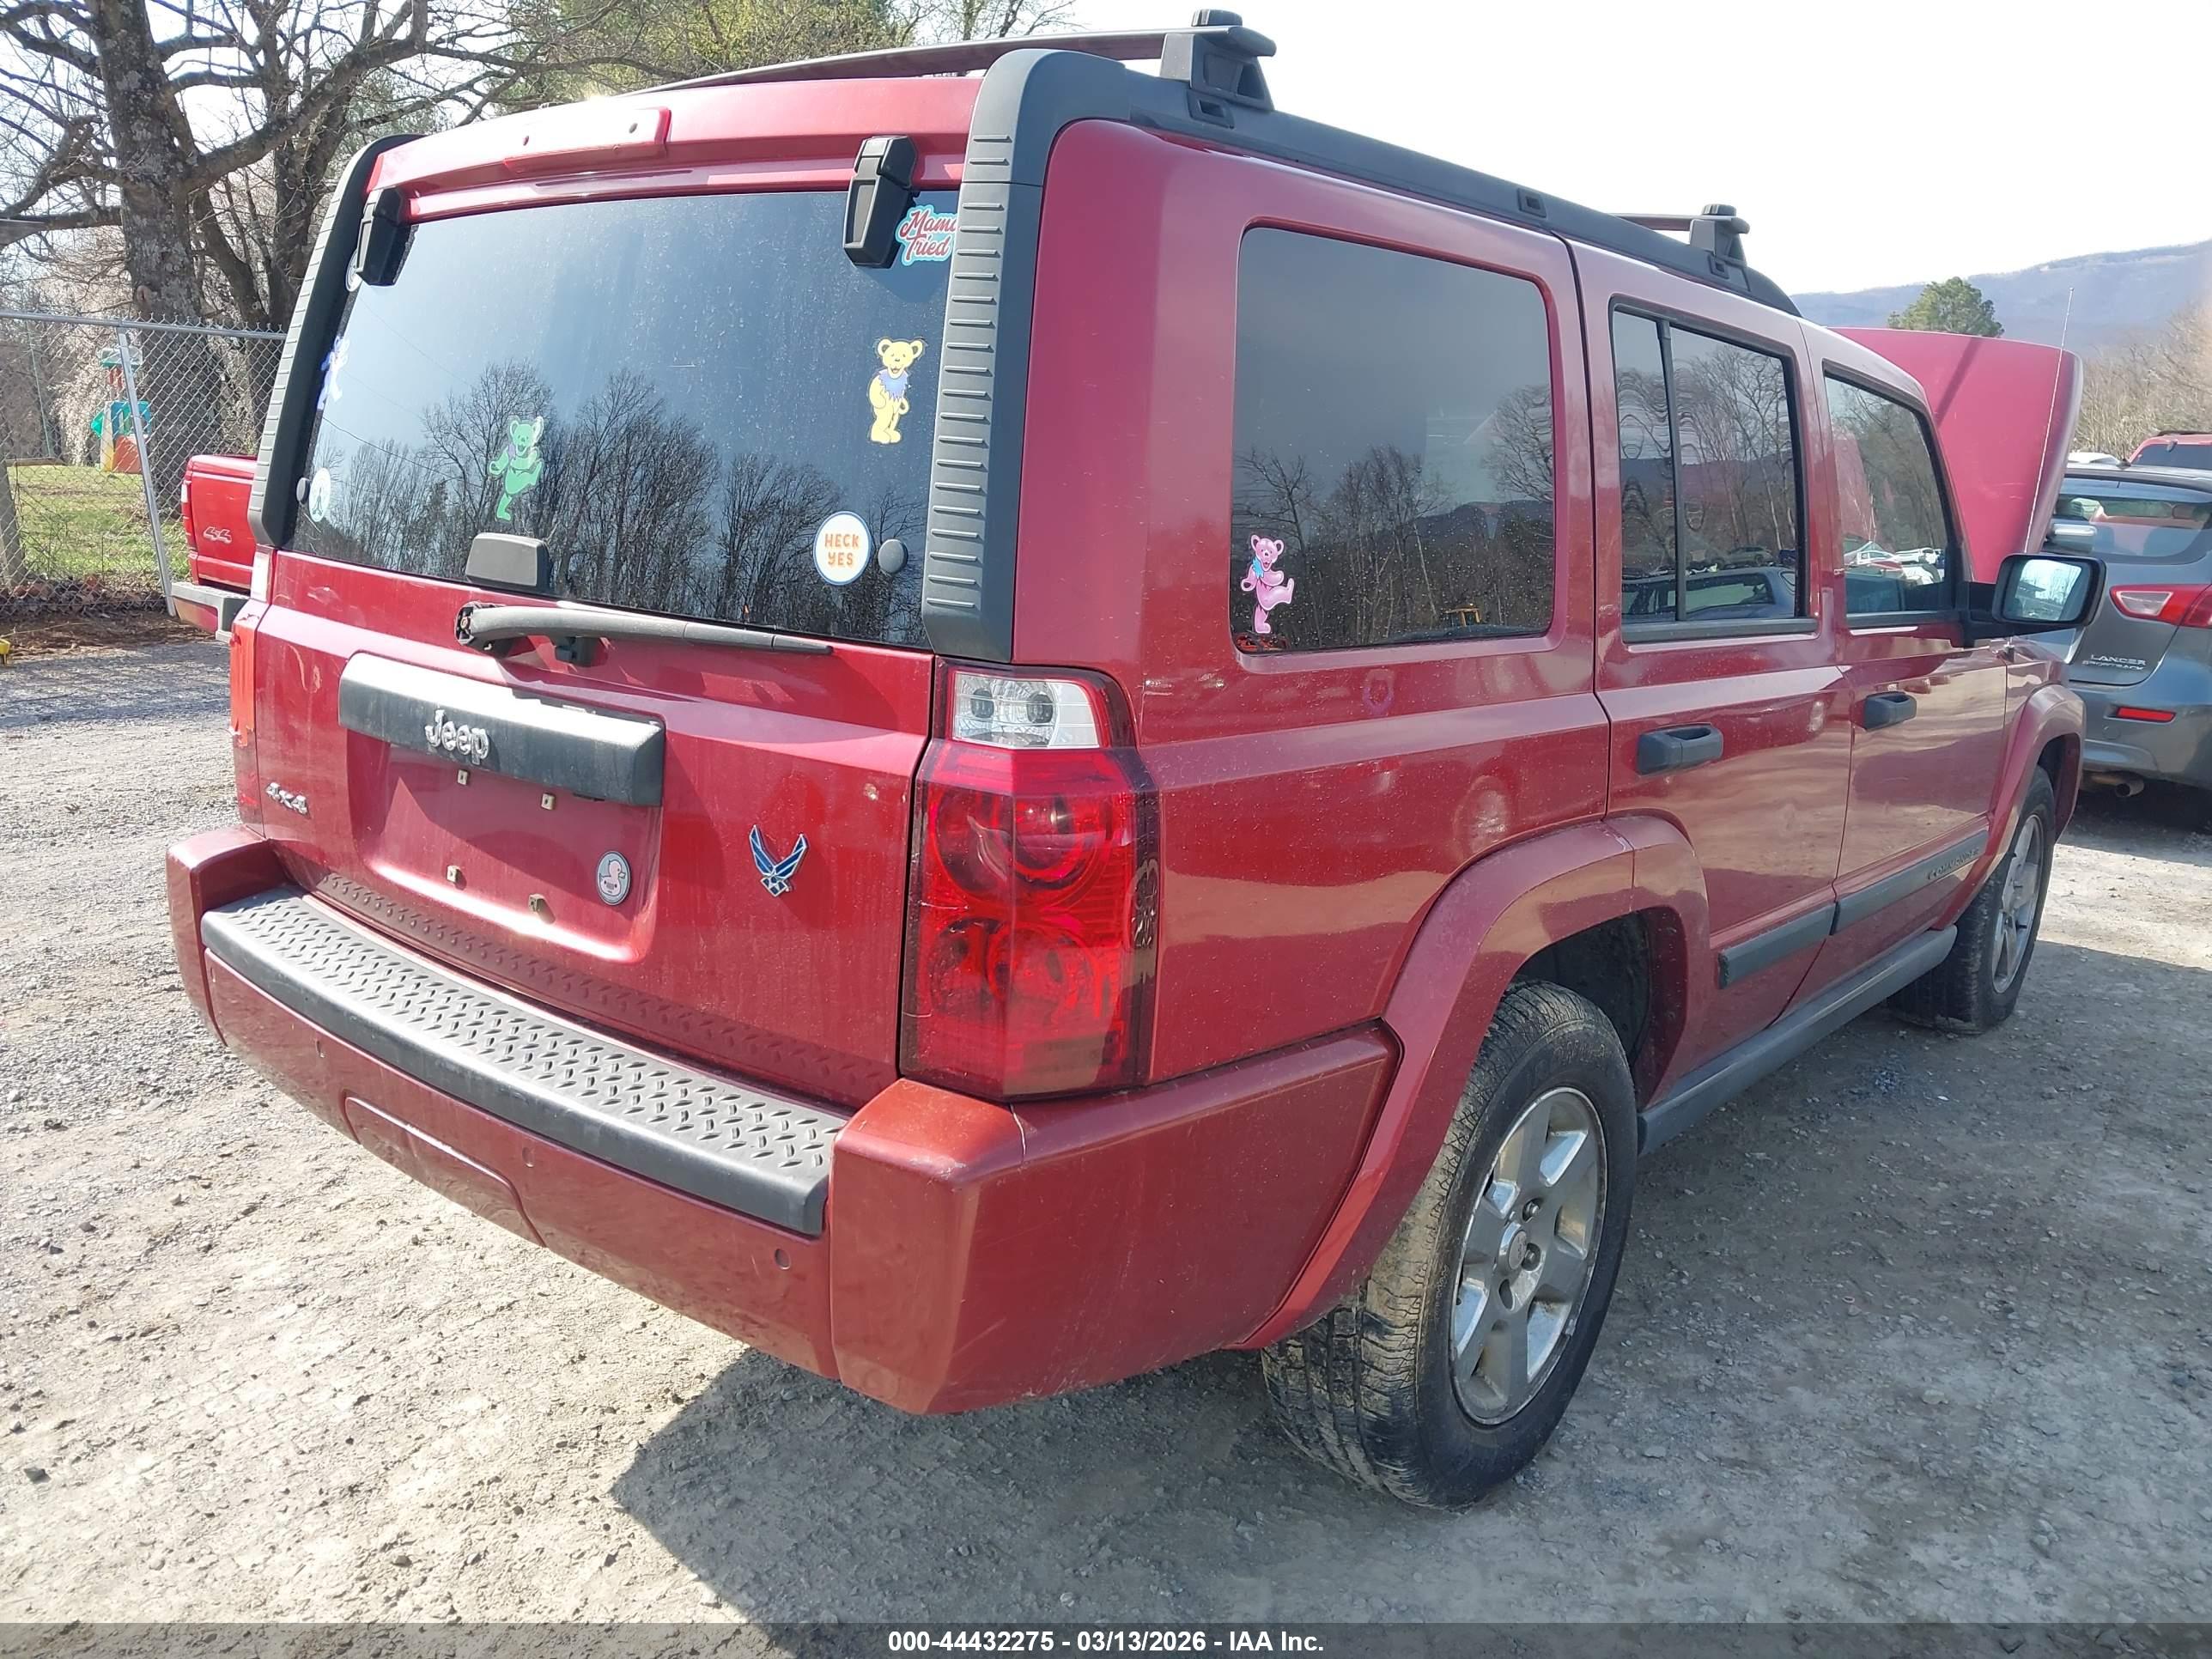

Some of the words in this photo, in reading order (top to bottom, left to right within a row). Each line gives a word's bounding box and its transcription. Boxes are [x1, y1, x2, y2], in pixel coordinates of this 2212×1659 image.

[907, 234, 951, 261] Tried
[824, 533, 860, 548] HECK
[827, 551, 854, 566] YES
[2090, 653, 2147, 666] LANCER
[424, 708, 489, 765] Jeep
